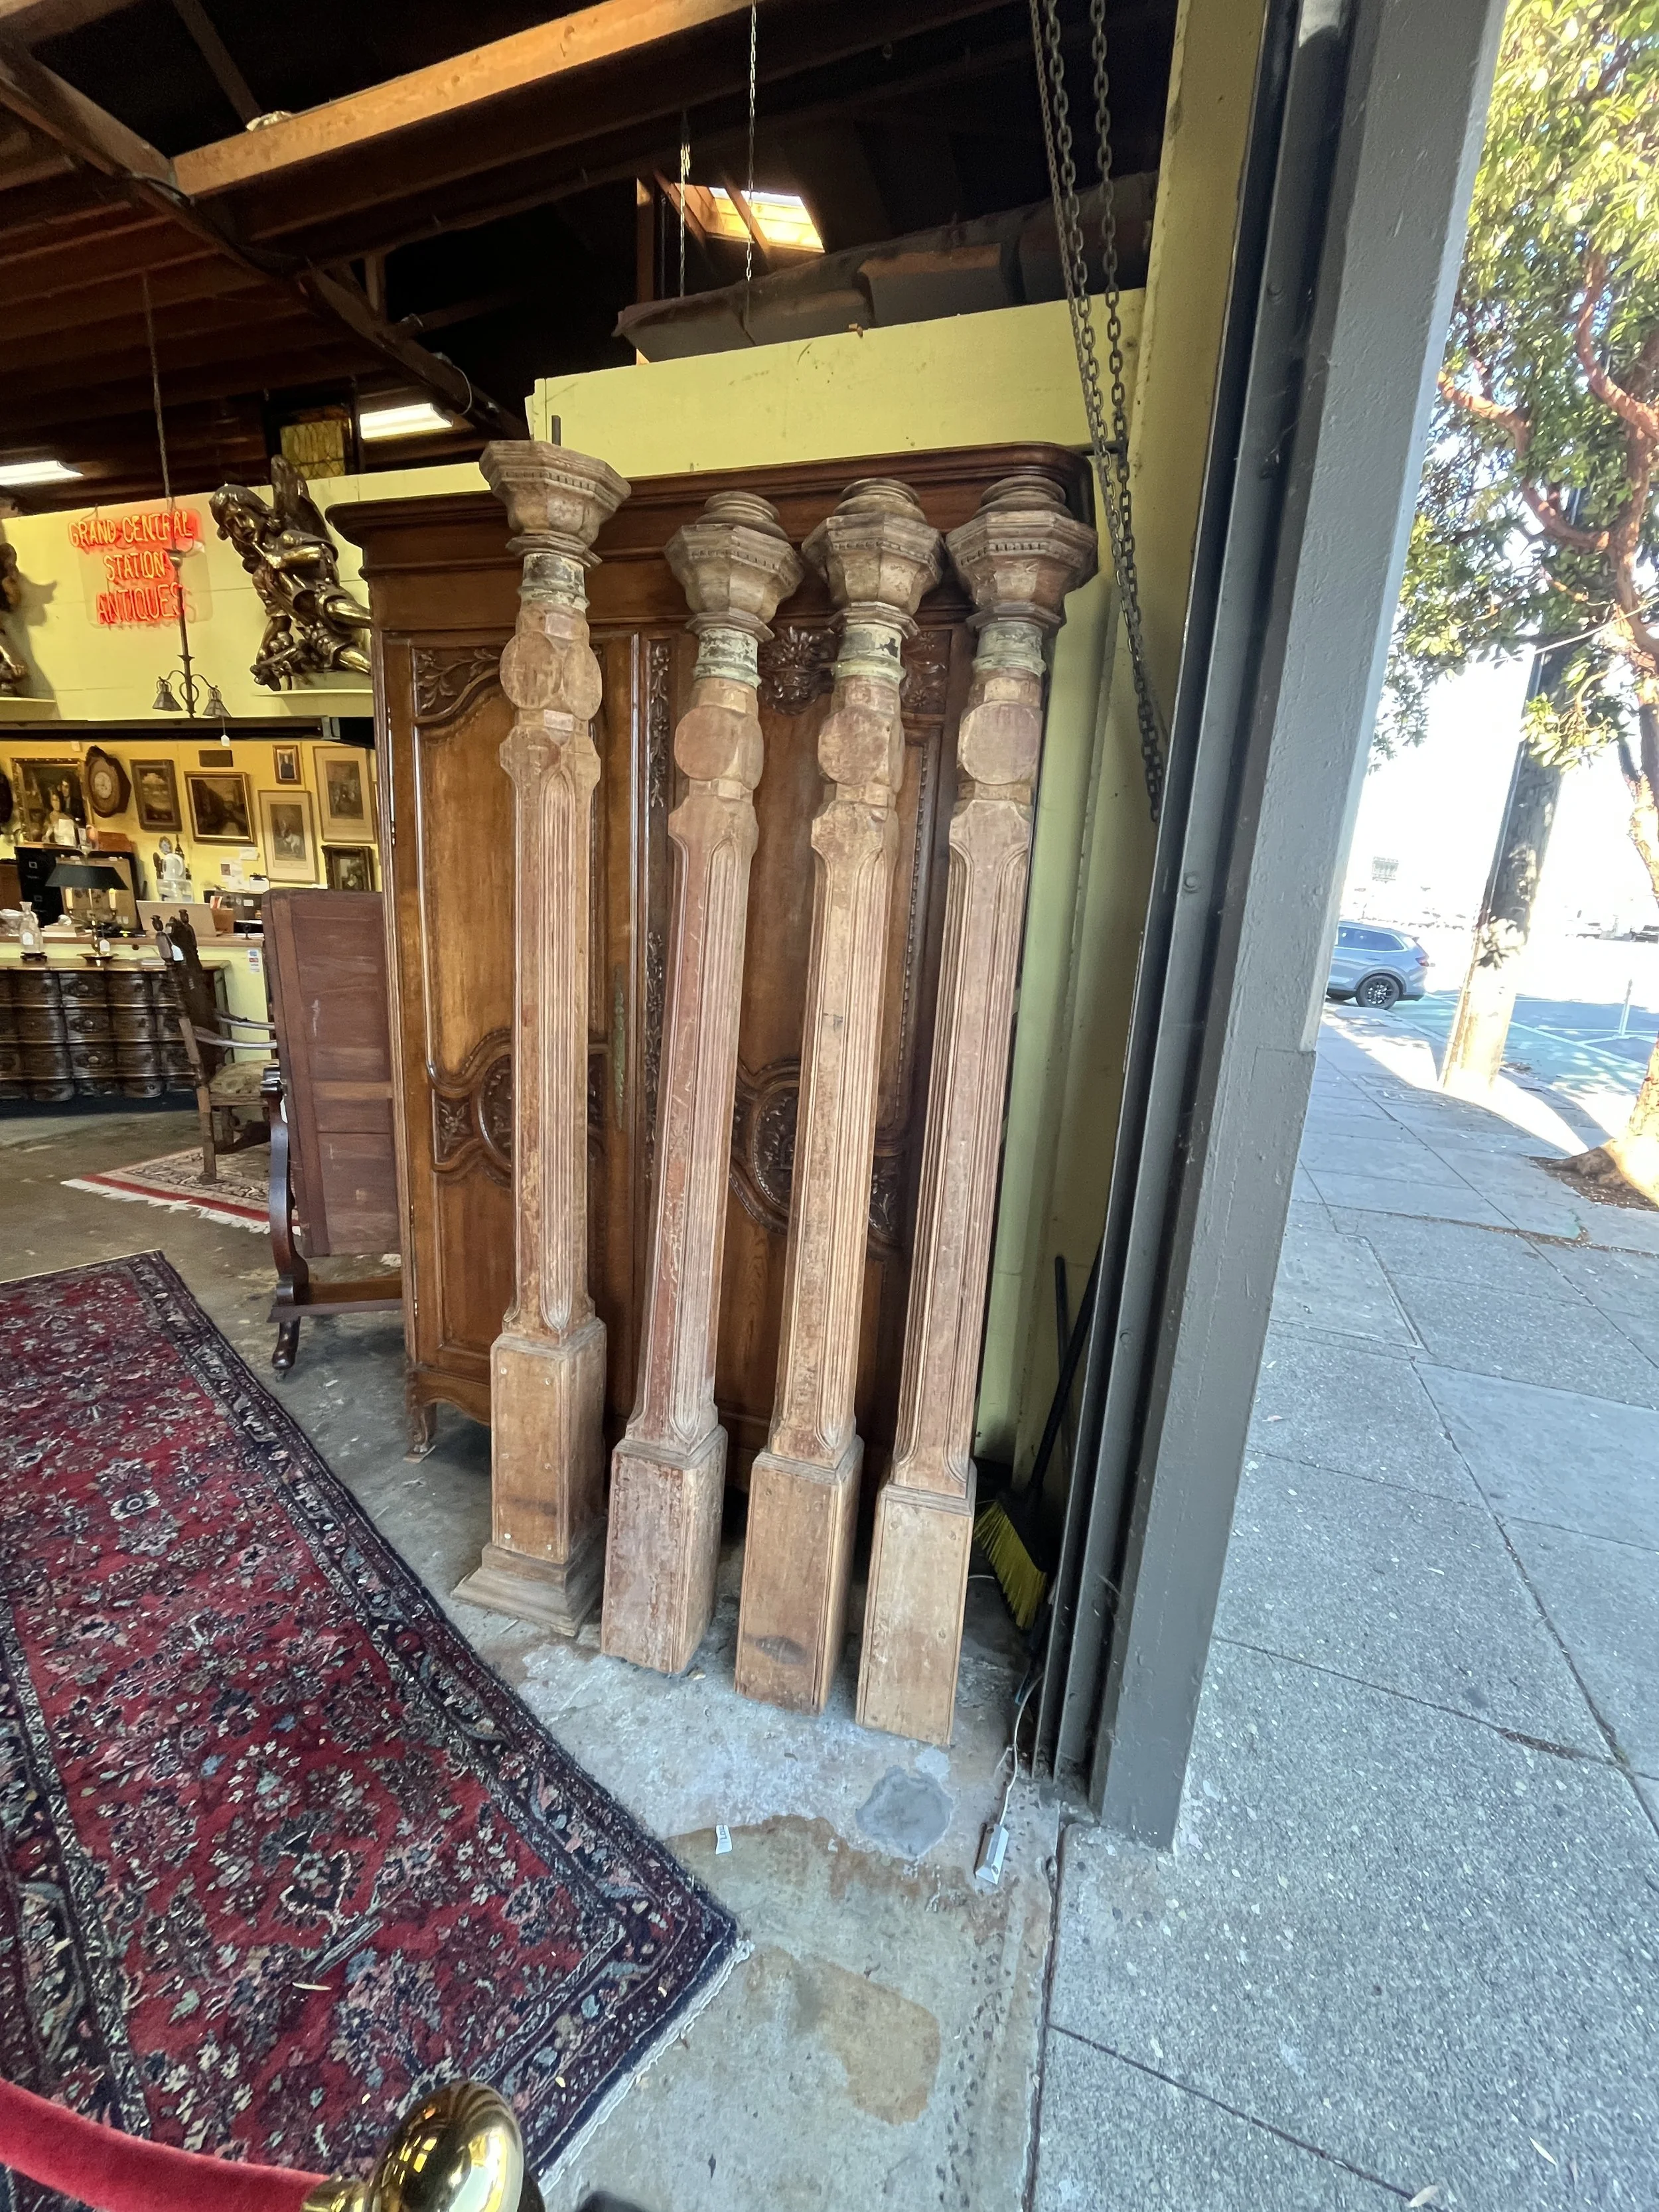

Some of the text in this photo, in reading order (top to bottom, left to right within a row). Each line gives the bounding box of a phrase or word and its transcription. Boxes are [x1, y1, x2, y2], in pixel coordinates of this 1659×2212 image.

[68, 510, 193, 547] GRAND CENTRAL
[103, 550, 166, 581] STATION
[96, 582, 183, 624] ANTIQUES
